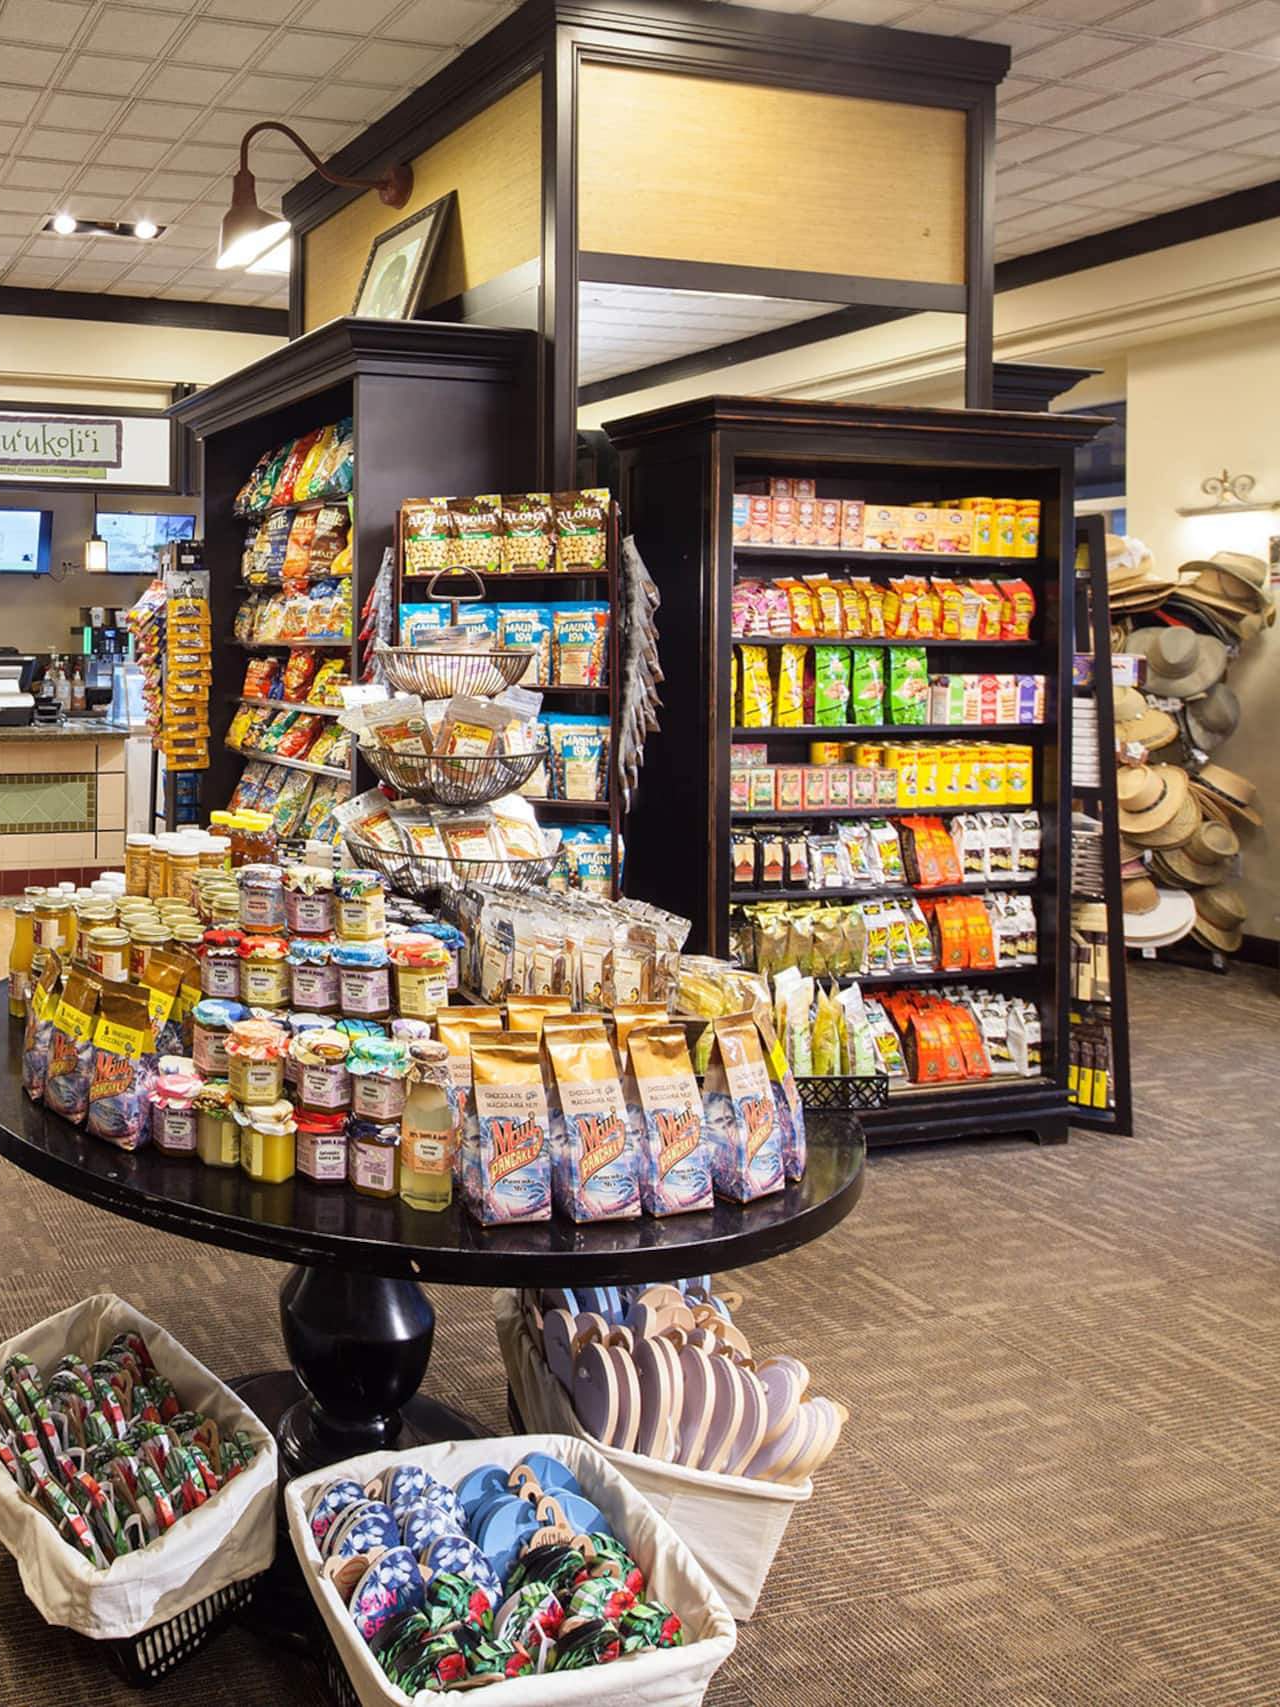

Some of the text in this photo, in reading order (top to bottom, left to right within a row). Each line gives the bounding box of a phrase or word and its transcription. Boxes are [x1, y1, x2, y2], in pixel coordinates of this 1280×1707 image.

[557, 507, 602, 523] ALOHA
[560, 623, 595, 634] MAUNA
[484, 1091, 523, 1101] CHOCOLATE
[568, 1088, 602, 1097] CHOCOLATE
[486, 1102, 539, 1110] MACADAMIA NUT
[570, 1097, 605, 1107] MACADAMIA
[577, 1113, 620, 1153] Maui
[655, 1107, 694, 1148] Maui
[491, 1116, 536, 1156] Maui
